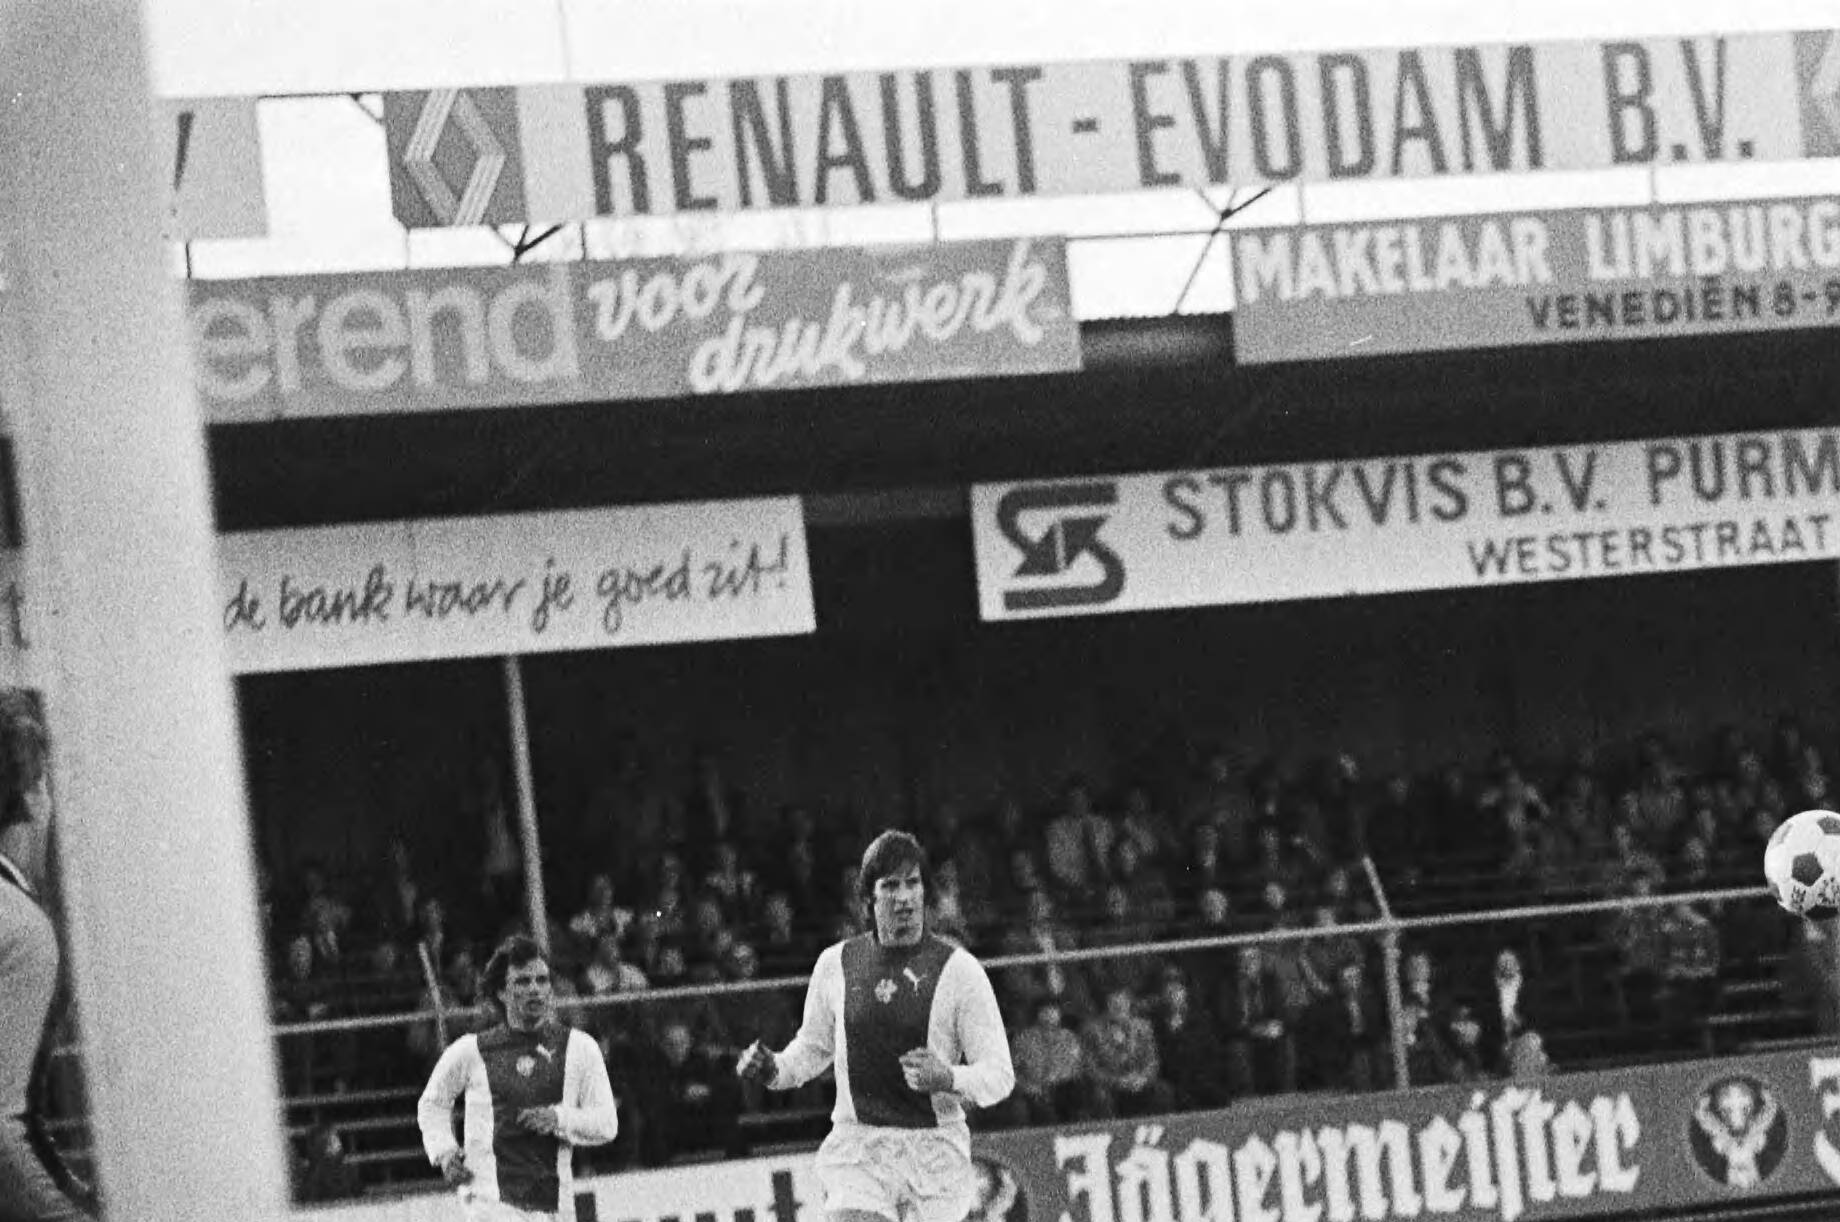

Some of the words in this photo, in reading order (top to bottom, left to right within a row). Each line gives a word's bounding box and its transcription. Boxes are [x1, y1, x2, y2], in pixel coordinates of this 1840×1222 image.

[1602, 36, 1754, 165] B.V.
[588, 254, 765, 340] voor
[1237, 217, 1551, 304] MAKELAAR
[1163, 461, 1468, 541] STOKVIS
[1495, 451, 1603, 516] B.V.
[224, 579, 265, 629] de
[279, 565, 393, 628] bank
[406, 577, 525, 618] waar
[532, 557, 574, 633] je
[598, 550, 691, 633] goed
[701, 534, 788, 598] zit!
[1468, 514, 1829, 577] WESTERSTRAAT
